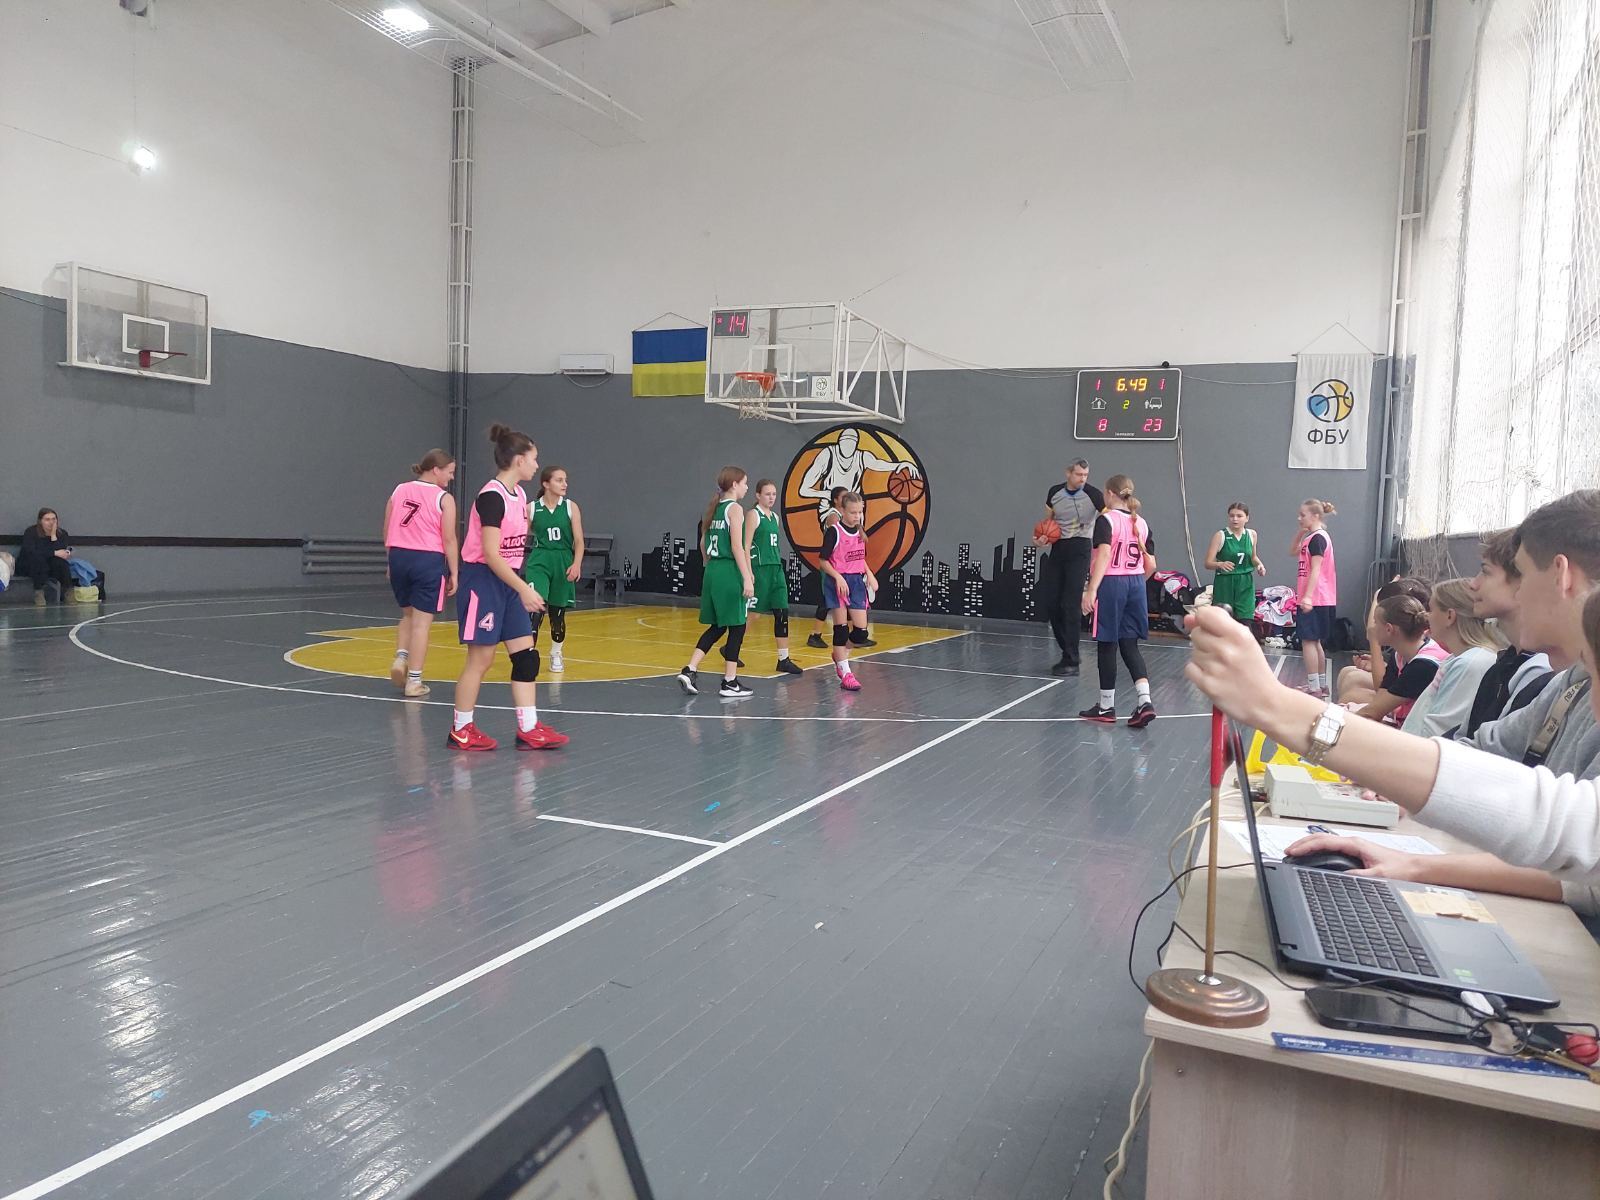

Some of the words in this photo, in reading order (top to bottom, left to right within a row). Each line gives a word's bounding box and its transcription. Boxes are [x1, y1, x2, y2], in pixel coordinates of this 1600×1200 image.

[729, 315, 746, 333] 14
[1096, 379, 1101, 391] 1
[1117, 378, 1148, 392] 6.49
[1159, 378, 1166, 390] 1
[1122, 399, 1130, 410] 2
[1098, 418, 1108, 432] 8
[1143, 418, 1163, 432] 23
[1307, 428, 1350, 445] ФБУ
[400, 499, 421, 528] 7
[547, 527, 561, 541] 10
[770, 533, 778, 546] 12
[1111, 541, 1141, 569] 19
[1237, 552, 1246, 565] 7
[478, 612, 495, 631] 4
